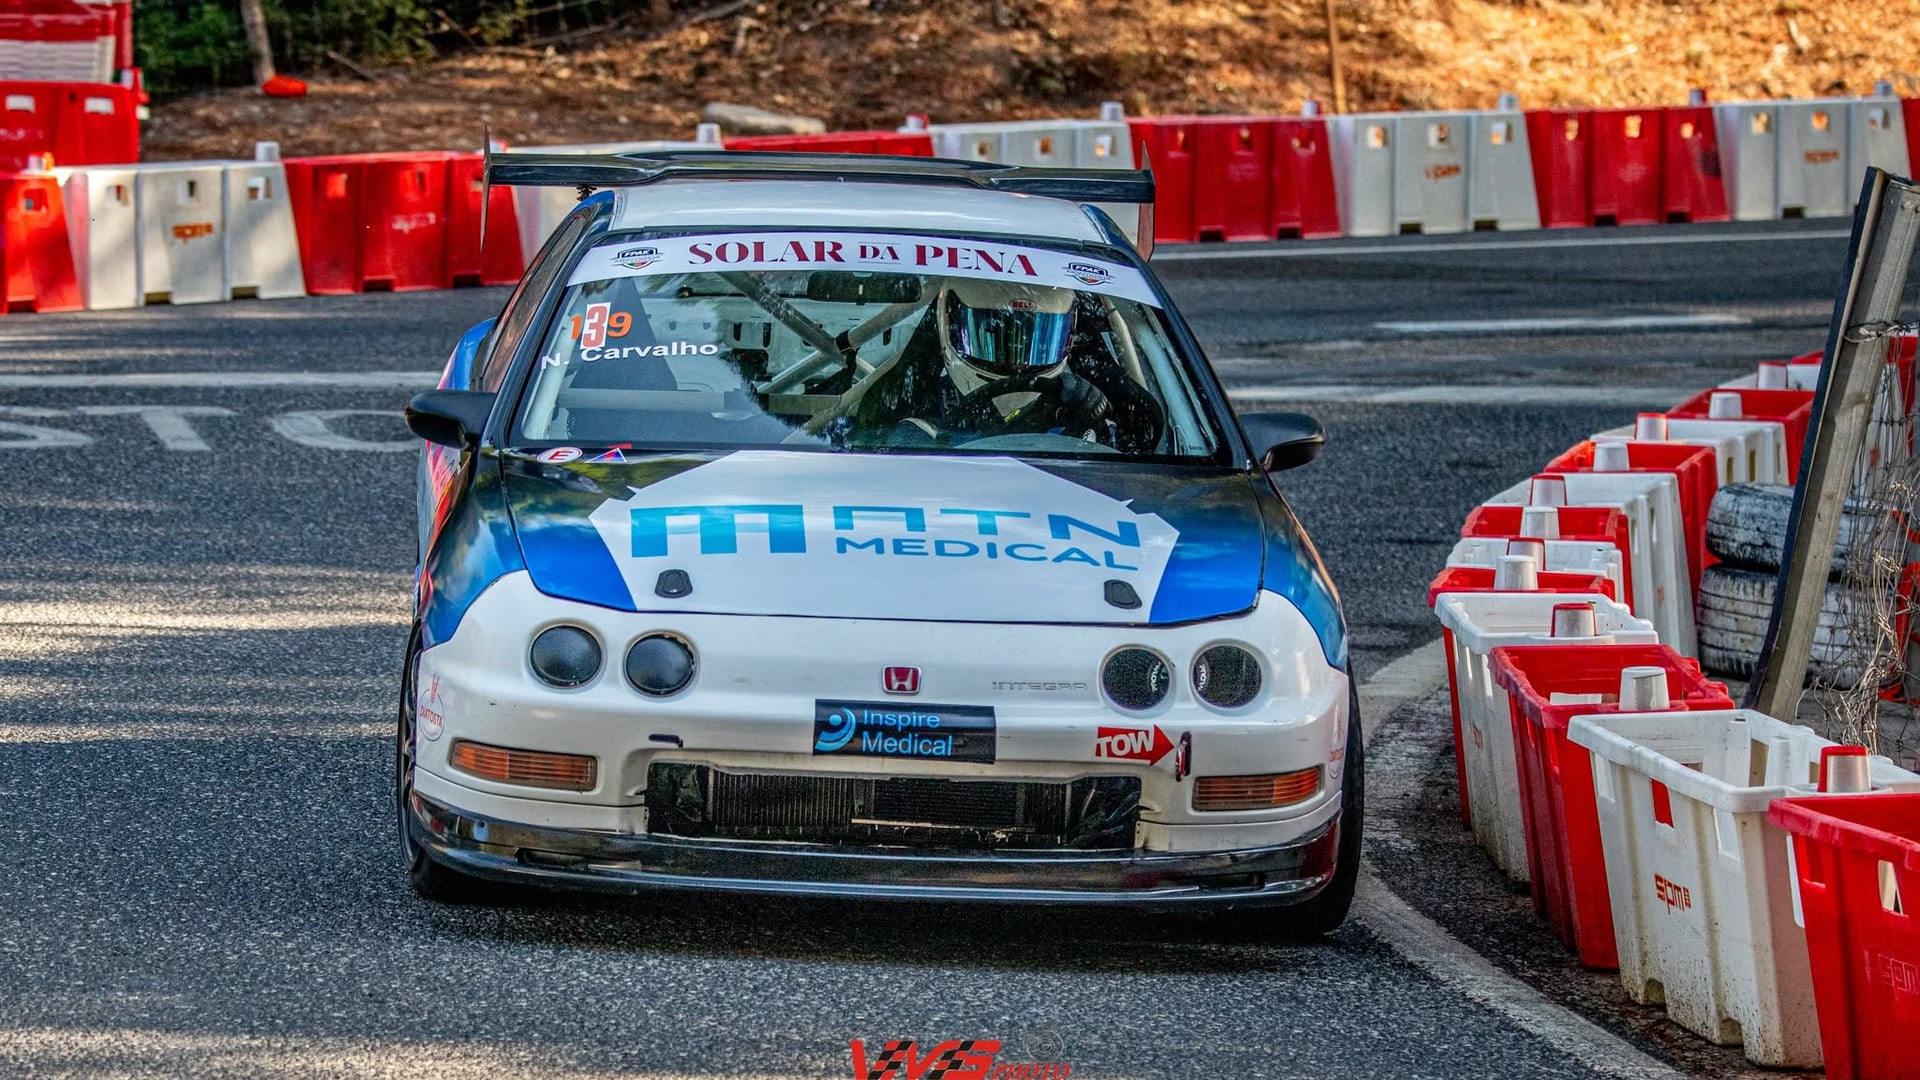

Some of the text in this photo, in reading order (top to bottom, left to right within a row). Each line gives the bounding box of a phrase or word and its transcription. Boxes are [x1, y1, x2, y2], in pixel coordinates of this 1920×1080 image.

[688, 240, 1039, 277] SOLAR DA PENA
[570, 306, 633, 348] 139
[541, 341, 718, 370] N. Carvalho
[0, 404, 423, 452] STO
[547, 450, 574, 461] E
[835, 537, 1139, 571] MEDICAL
[992, 681, 1088, 691] INTEGRA
[863, 709, 941, 731] Inspire
[862, 731, 953, 756] Medical
[1096, 730, 1154, 761] TOW
